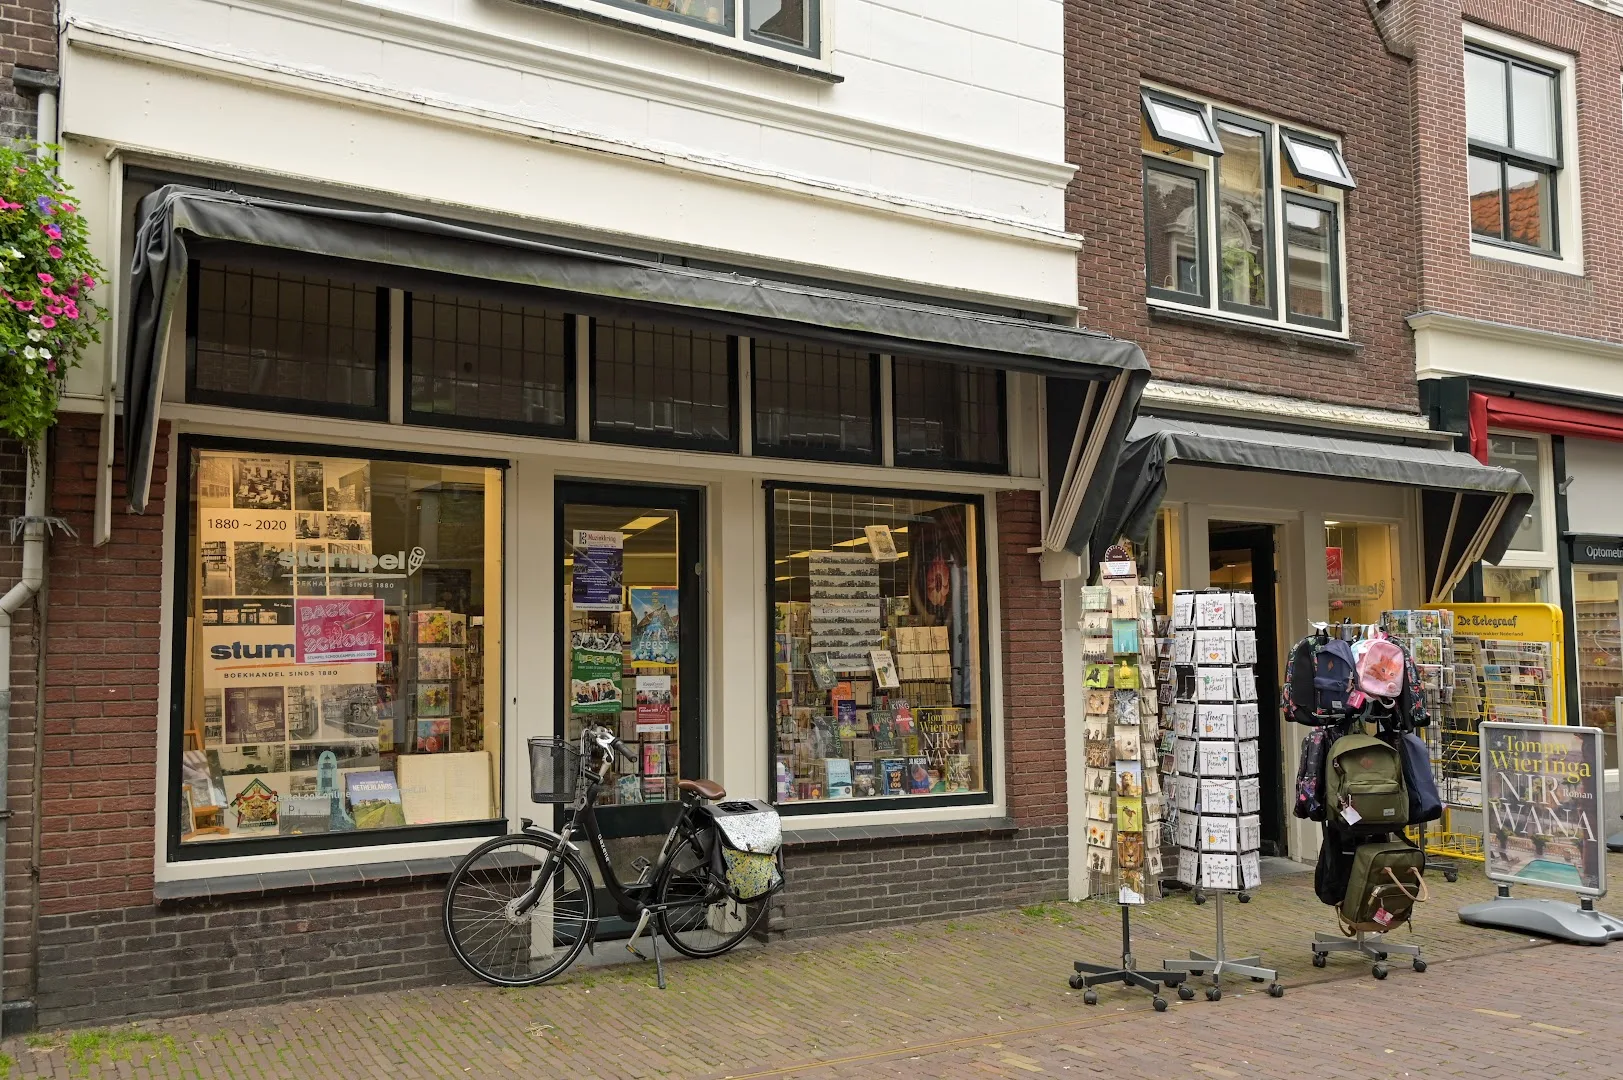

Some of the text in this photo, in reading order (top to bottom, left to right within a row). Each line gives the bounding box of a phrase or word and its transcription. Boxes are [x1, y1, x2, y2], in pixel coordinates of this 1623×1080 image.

[207, 518, 240, 530] 1880
[255, 519, 287, 531] 2020
[279, 550, 406, 573] stumpel
[300, 601, 355, 622] BACK
[1457, 615, 1518, 628] De Telegraaf
[210, 641, 295, 660] stum
[303, 631, 381, 653] SCHOOL
[223, 671, 285, 679] BOEKHANDEL
[891, 702, 910, 710] KING
[926, 712, 954, 723] Tommy
[919, 721, 964, 735] Wieringa
[923, 732, 952, 750] NIR
[1503, 735, 1569, 760] Tommy
[919, 749, 963, 766] WA
[1489, 749, 1592, 784] Wieringa
[323, 789, 351, 799] online
[352, 783, 393, 792] NETHERLANDS
[1498, 771, 1563, 806] NIR
[1562, 788, 1593, 800] Roman
[1488, 800, 1598, 842] WANA
